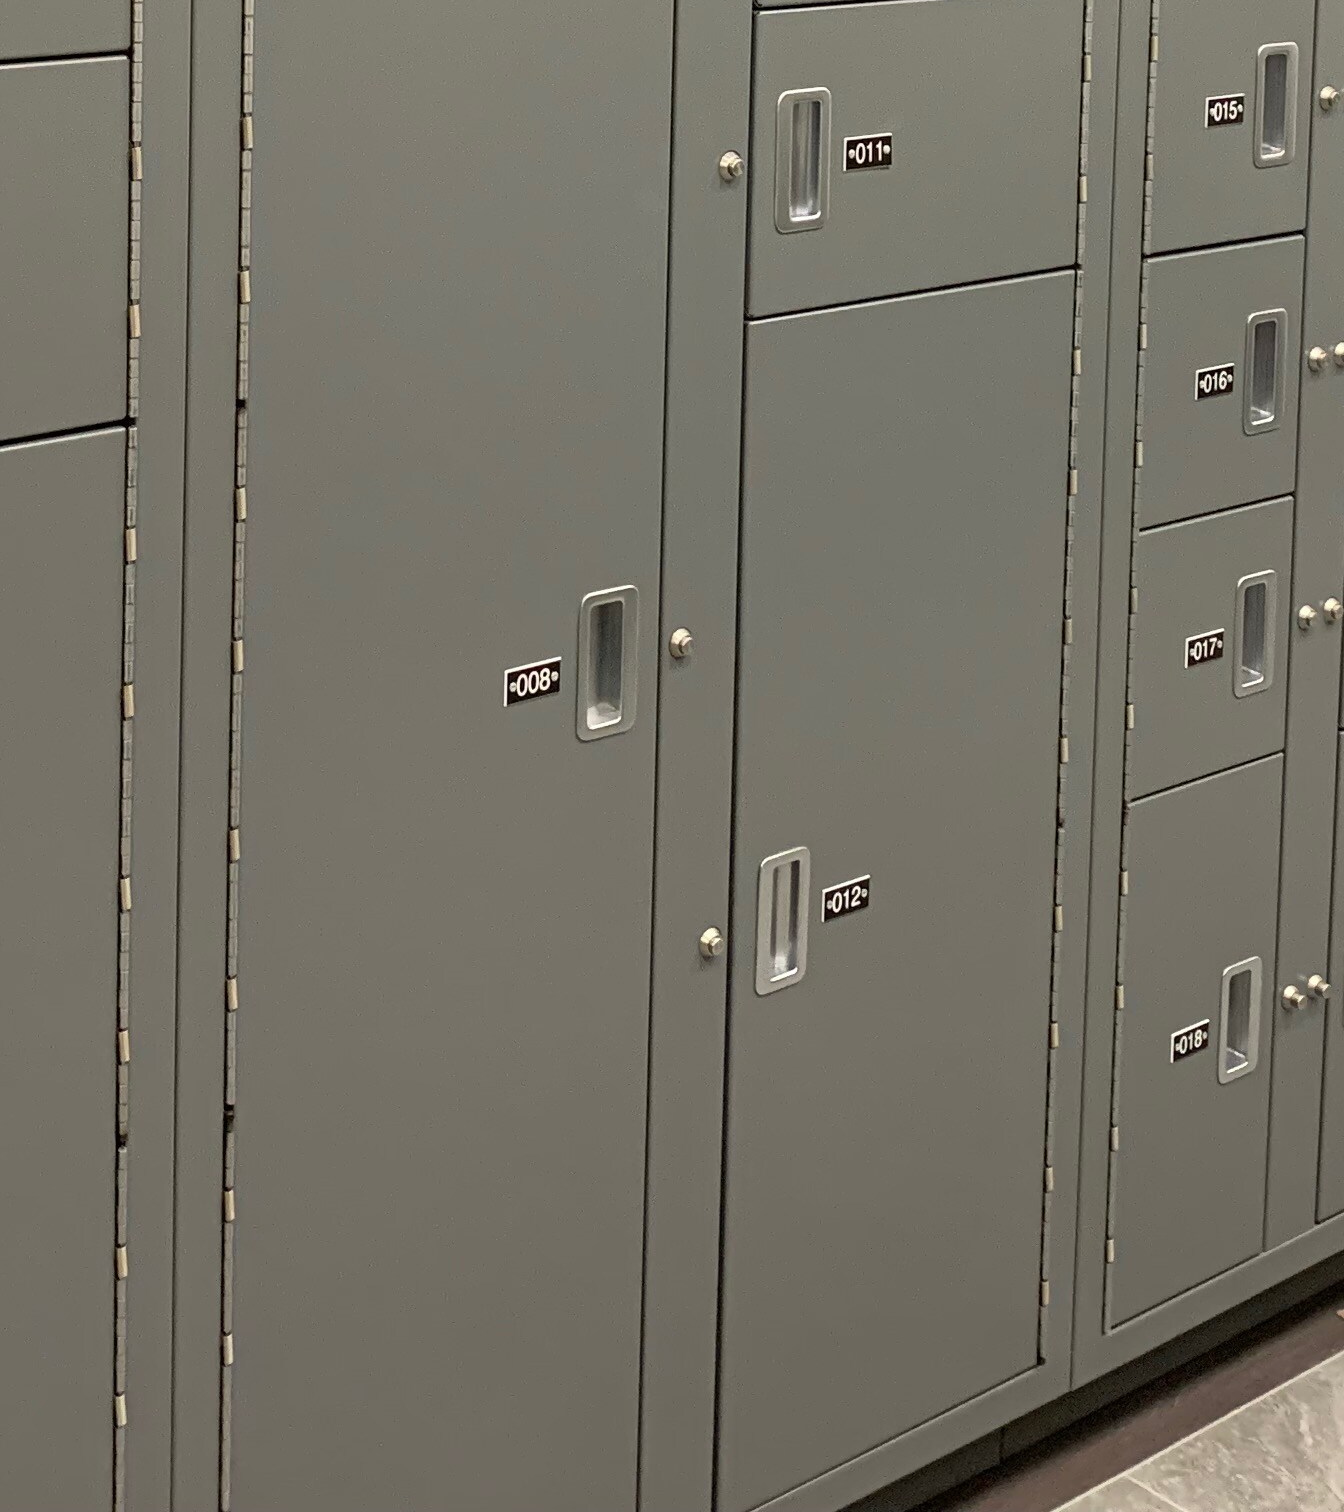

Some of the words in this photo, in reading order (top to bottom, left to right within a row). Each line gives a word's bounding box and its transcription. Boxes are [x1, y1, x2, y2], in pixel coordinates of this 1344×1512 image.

[1213, 100, 1237, 121] 015
[855, 141, 884, 163] 011
[1204, 371, 1227, 393] 016
[1194, 637, 1217, 660] 017
[516, 668, 552, 696] 008
[832, 886, 862, 912] 012
[1179, 1029, 1202, 1054] 018
